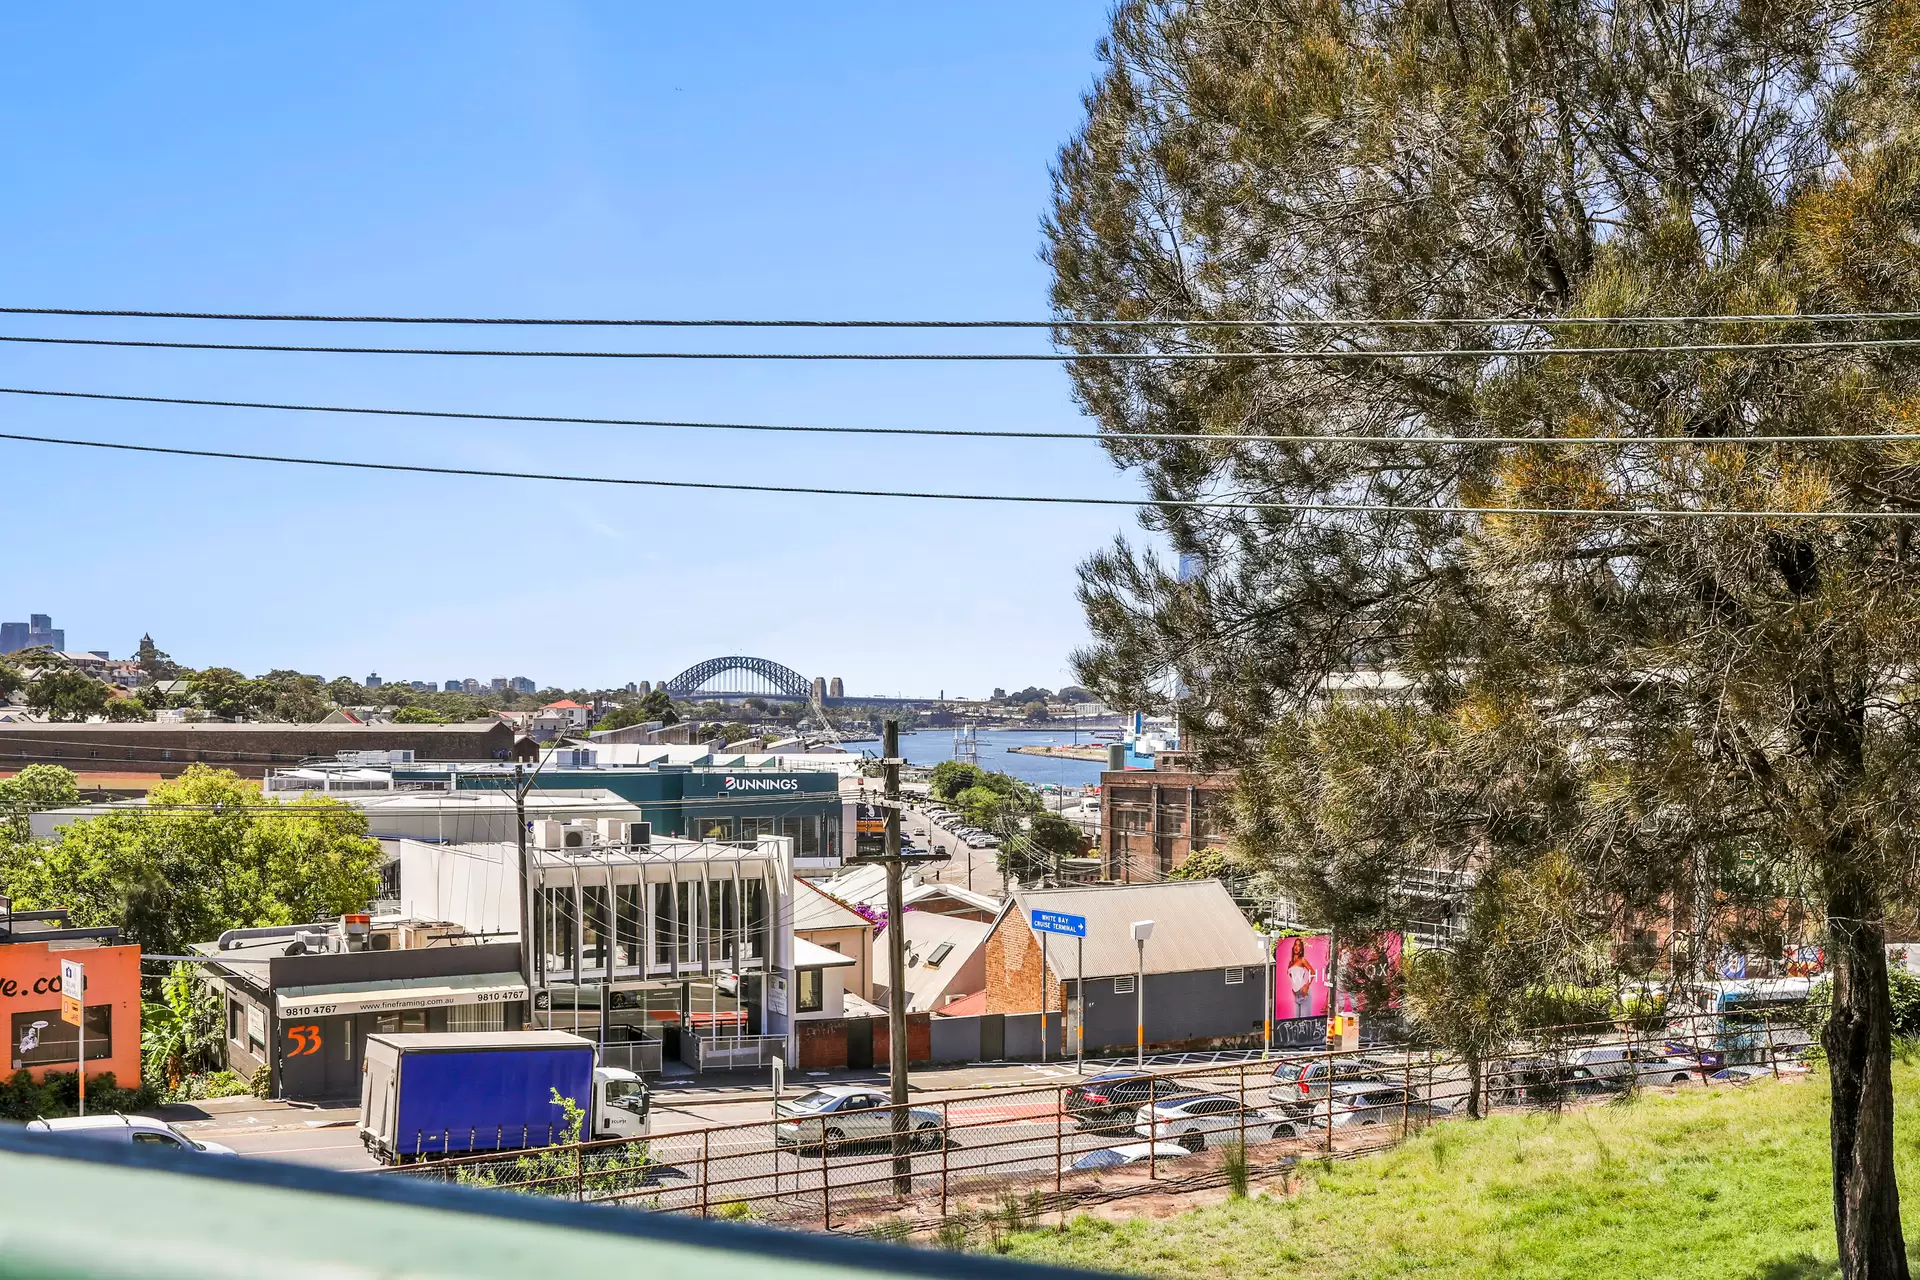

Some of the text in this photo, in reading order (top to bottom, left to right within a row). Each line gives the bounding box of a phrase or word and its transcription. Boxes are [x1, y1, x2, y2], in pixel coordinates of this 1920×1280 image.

[725, 776, 798, 790] BUNNINGS
[1041, 914, 1057, 922] WHITE
[1033, 920, 1077, 933] CRUISE TERMINAL
[0, 975, 88, 997] e.co
[477, 991, 524, 1002] 9810 4767
[359, 997, 455, 1011] www.fineframing.com.au
[285, 1005, 337, 1017] 9810 4767
[286, 1025, 322, 1058] 53
